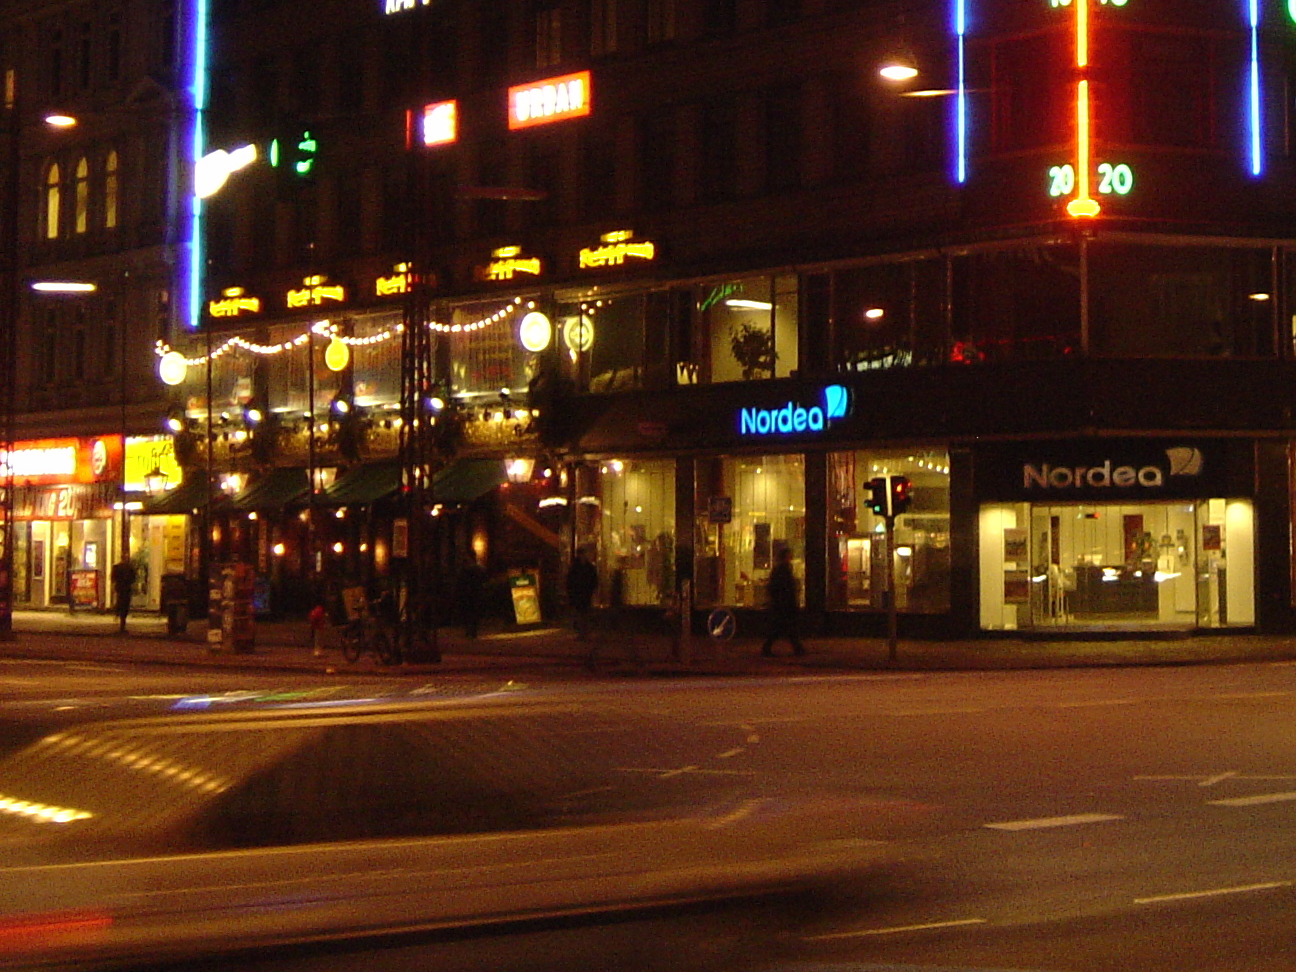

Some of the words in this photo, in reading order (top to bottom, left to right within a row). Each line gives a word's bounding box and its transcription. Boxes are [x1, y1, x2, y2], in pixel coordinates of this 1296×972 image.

[1049, 164, 1075, 197] 20
[1097, 163, 1133, 195] 20
[741, 402, 824, 434] Nordea
[1022, 460, 1163, 489] Nordea
